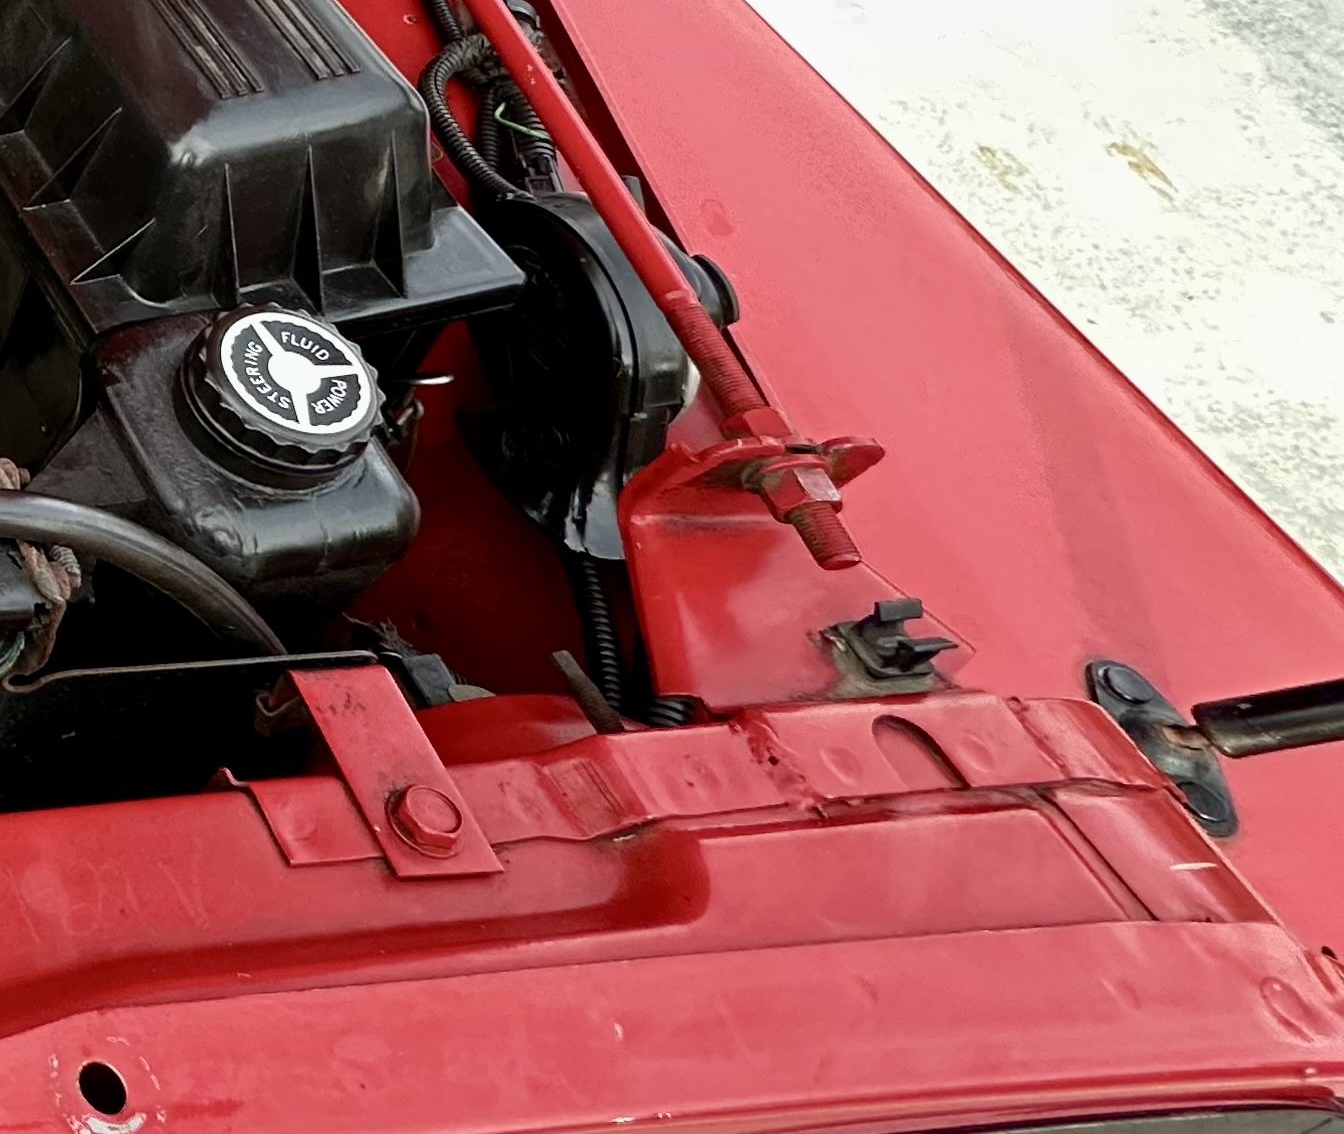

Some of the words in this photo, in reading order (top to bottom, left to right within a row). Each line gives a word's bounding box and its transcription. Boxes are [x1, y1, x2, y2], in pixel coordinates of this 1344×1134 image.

[280, 331, 330, 361] FLUID
[243, 341, 292, 409] STEERING
[311, 379, 348, 415] POWER
